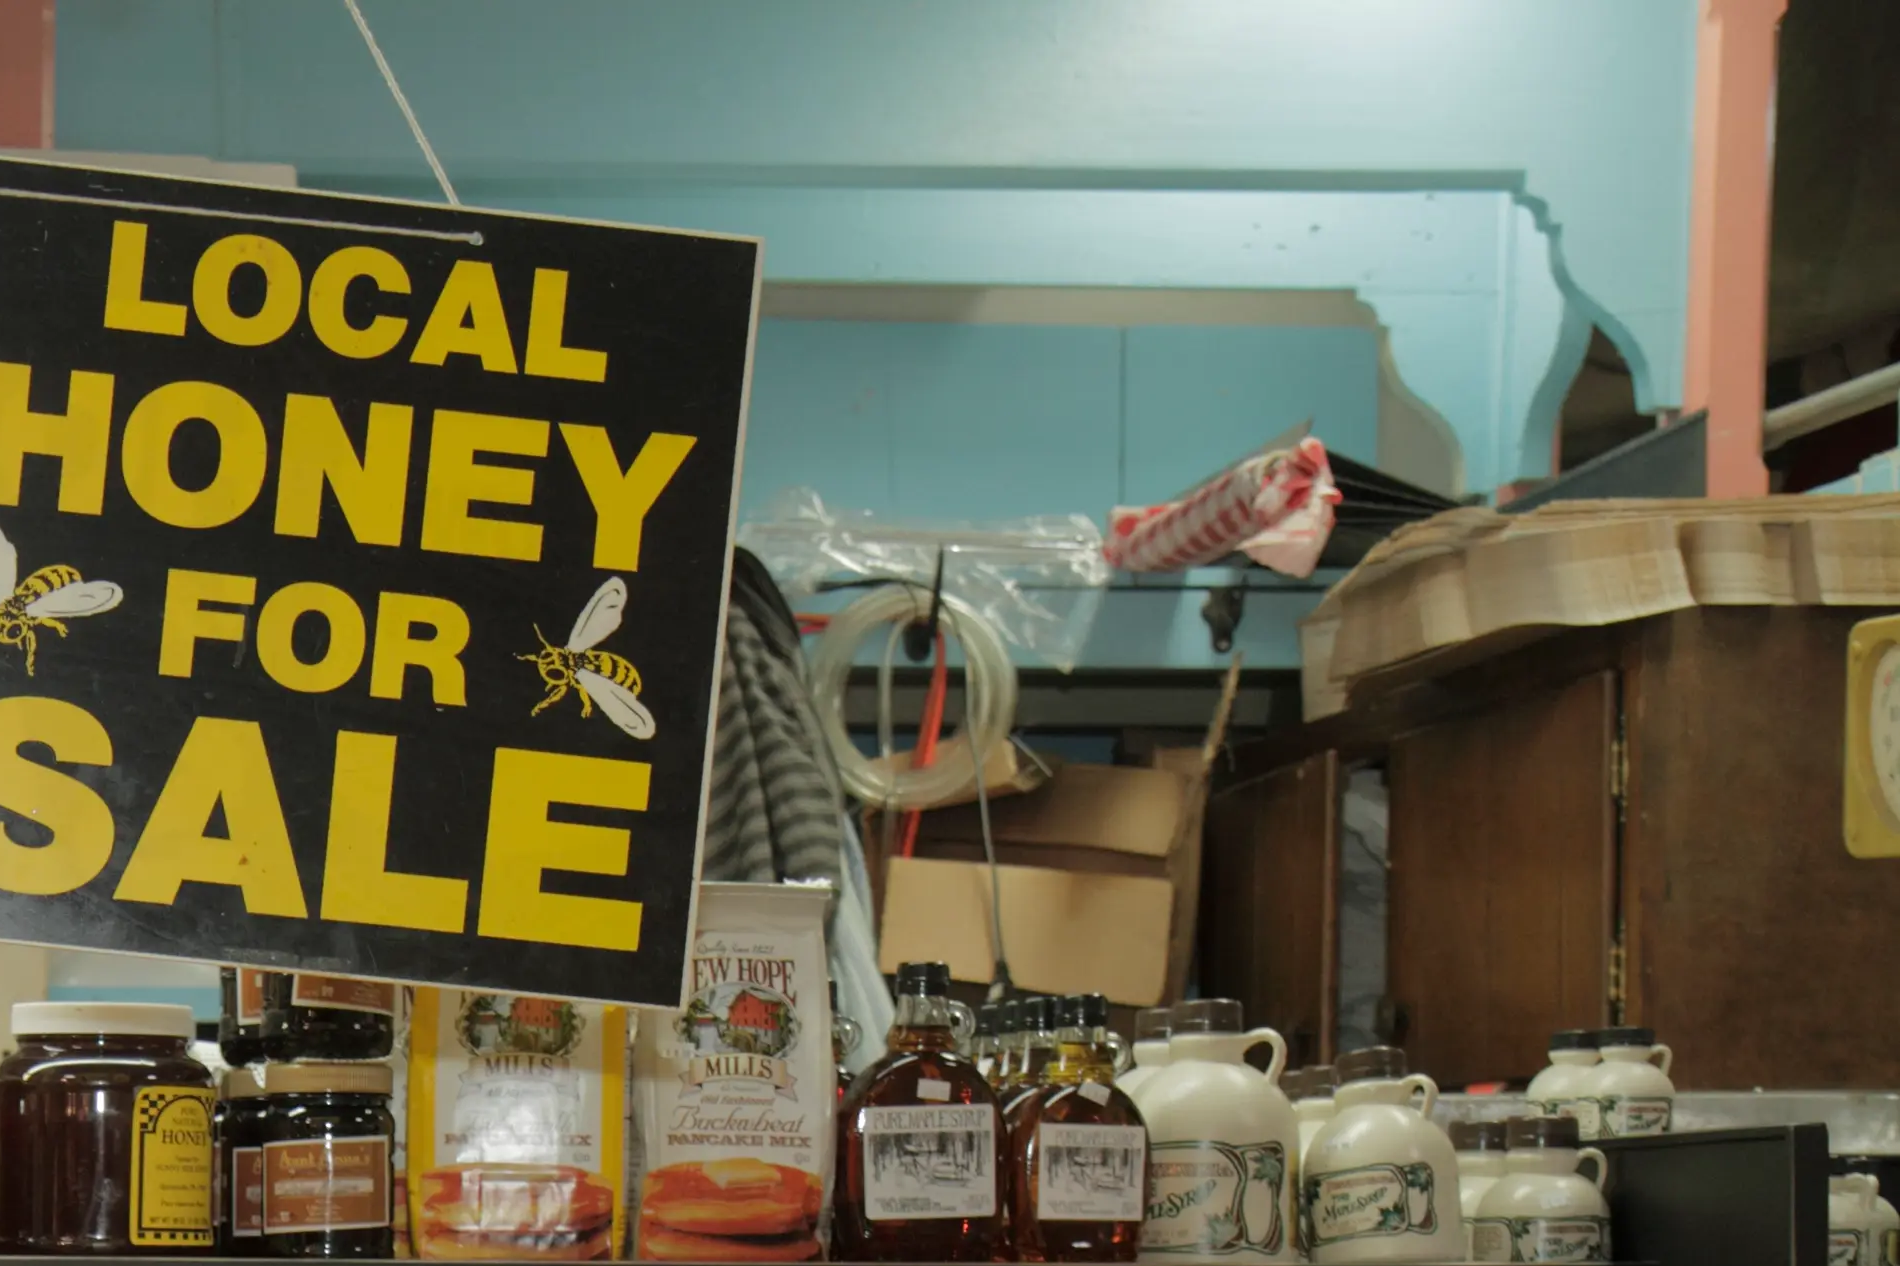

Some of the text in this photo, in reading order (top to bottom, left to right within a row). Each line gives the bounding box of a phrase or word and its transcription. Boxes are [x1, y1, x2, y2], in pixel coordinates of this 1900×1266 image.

[104, 220, 608, 384] LOCAL
[158, 568, 471, 708] FOR
[692, 957, 796, 1006] EW HOPE
[485, 1056, 554, 1076] MILLS
[705, 1056, 773, 1079] MILLS
[669, 1105, 806, 1134] Buckwheat
[667, 1134, 812, 1148] PANCAKE MIX
